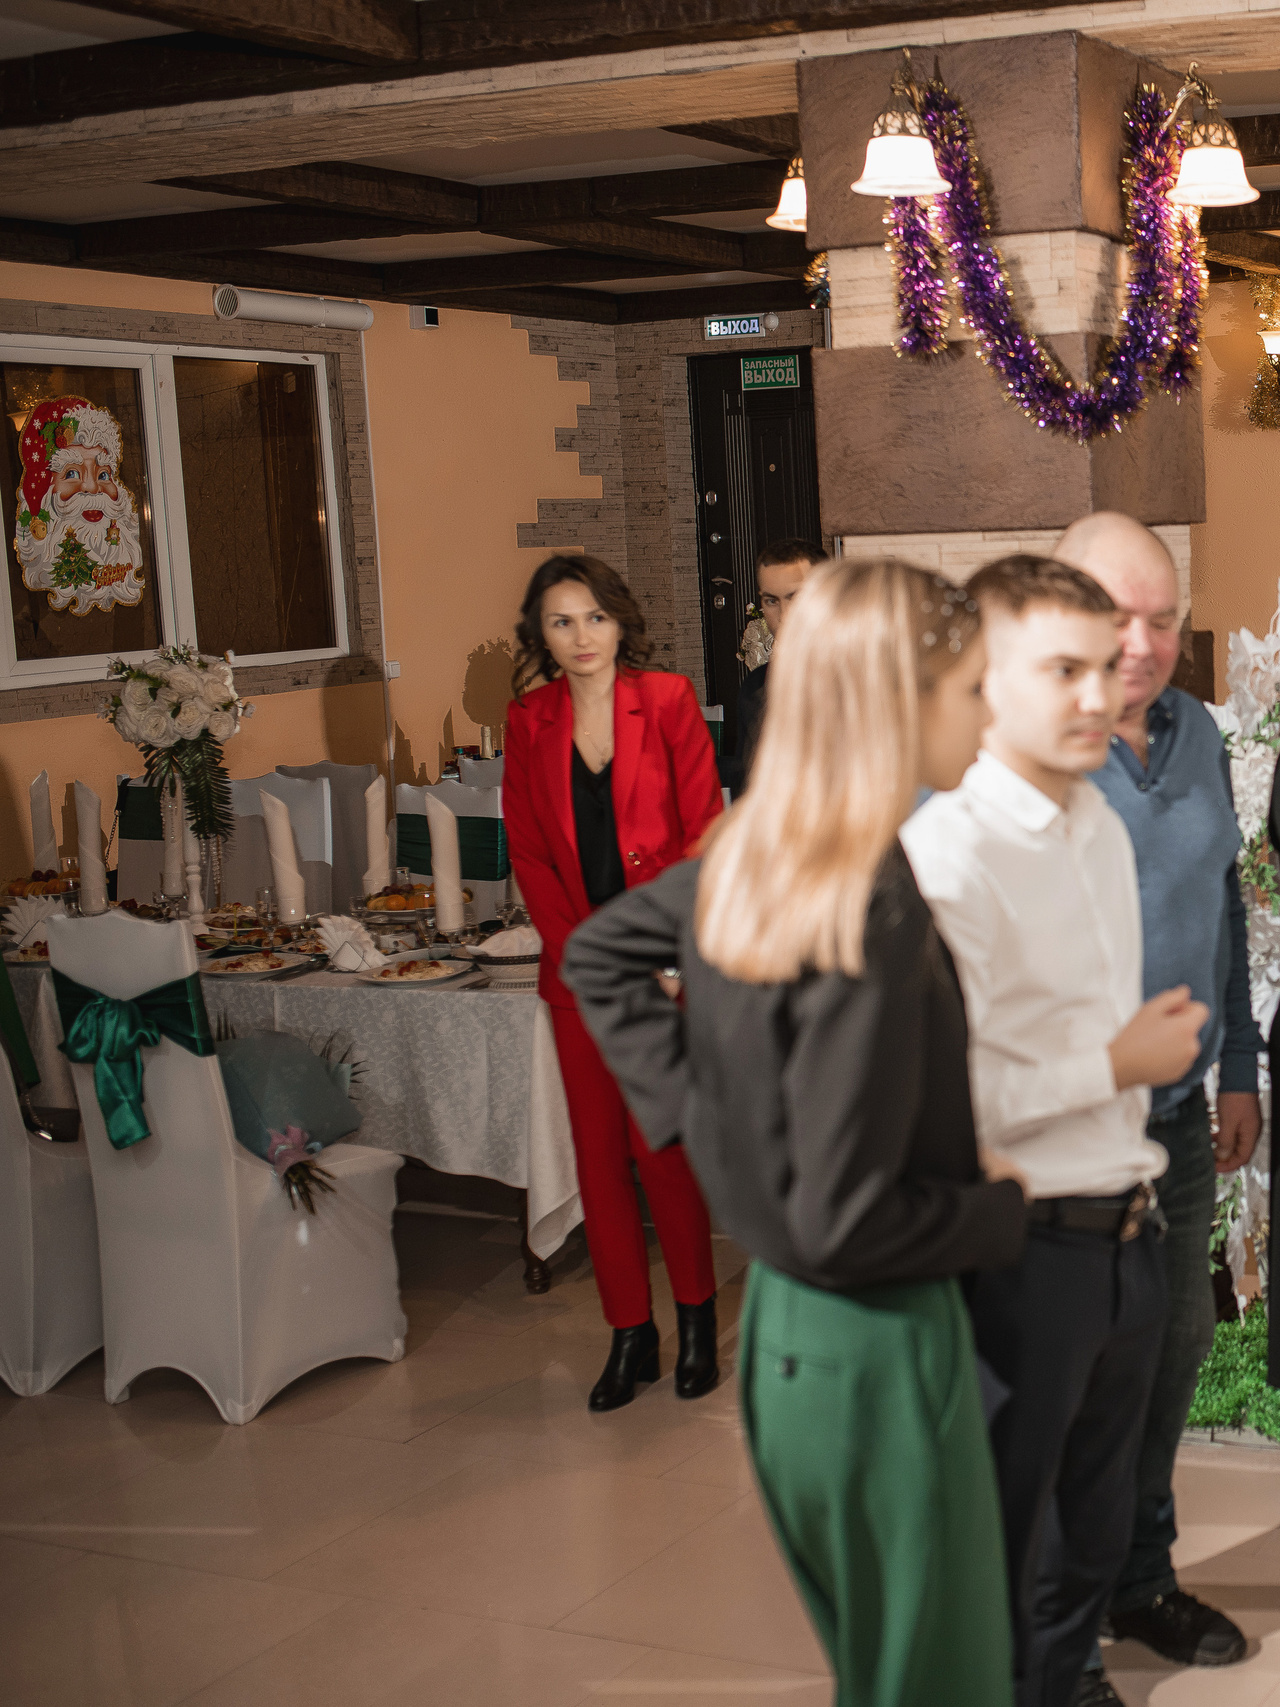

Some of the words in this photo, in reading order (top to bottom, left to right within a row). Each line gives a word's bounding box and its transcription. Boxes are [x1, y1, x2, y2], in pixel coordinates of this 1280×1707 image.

[710, 319, 759, 335] ВЫХОД
[744, 358, 794, 369] ЗАПАСНЫЙ
[744, 367, 796, 384] ВЫХОД
